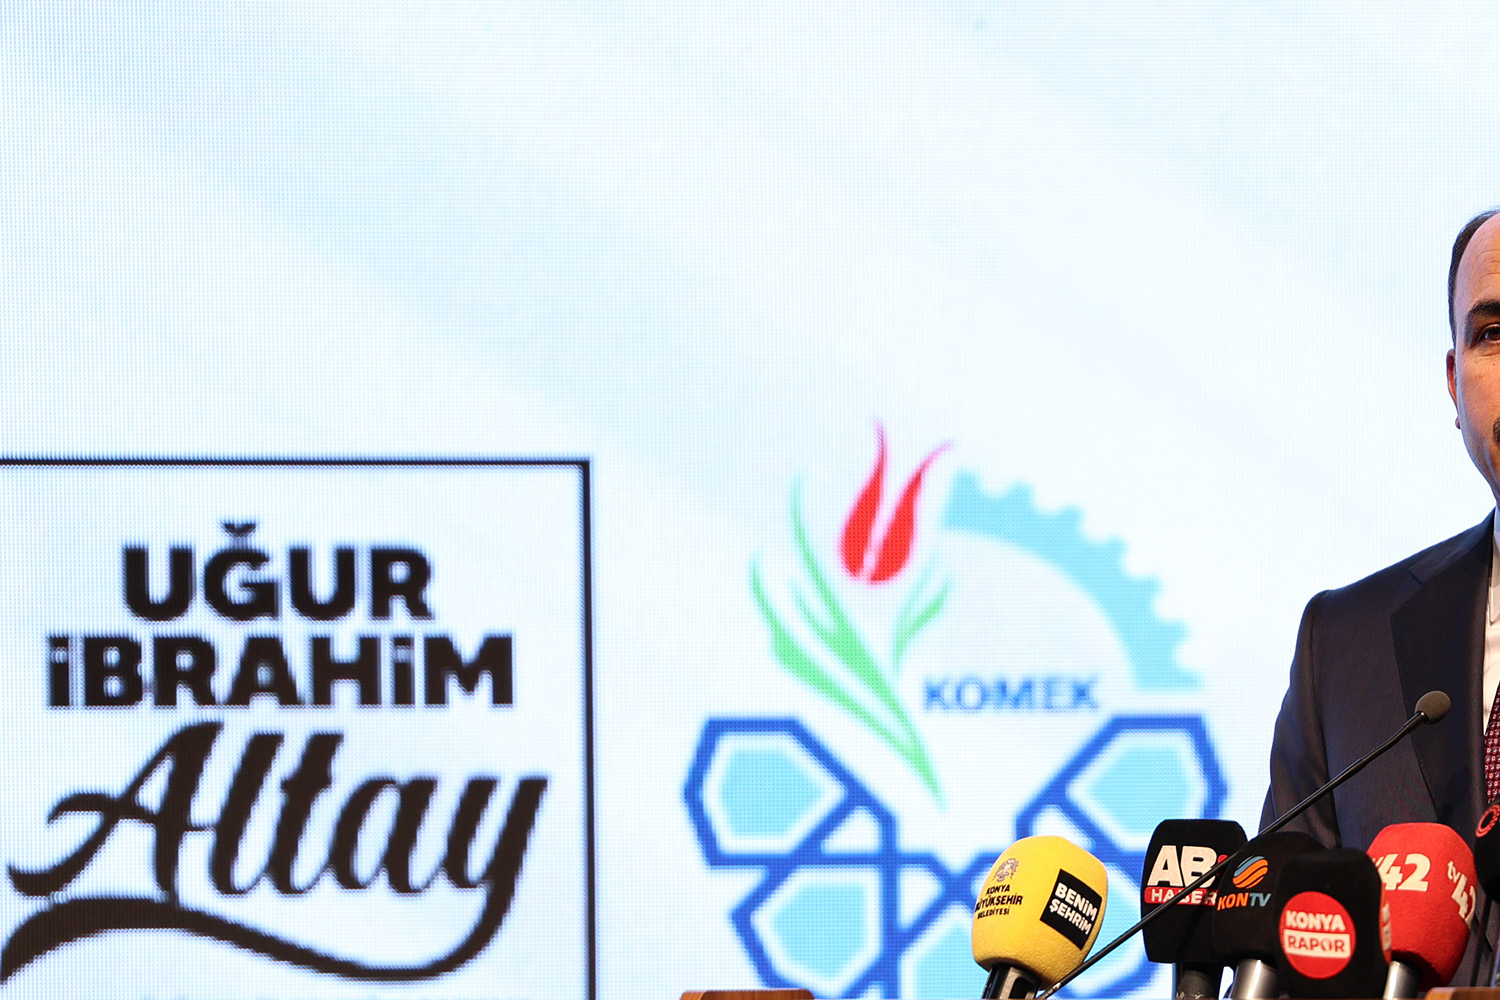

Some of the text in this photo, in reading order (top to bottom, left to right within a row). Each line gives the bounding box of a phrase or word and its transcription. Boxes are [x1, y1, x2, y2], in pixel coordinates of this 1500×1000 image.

[122, 520, 435, 621] UĞUR
[47, 633, 515, 708] İBRAHİM
[925, 678, 1100, 711] KOMEK
[0, 720, 548, 985] Altay
[985, 884, 1011, 896] KONYA
[1054, 882, 1099, 921] BENİM
[1216, 892, 1272, 911] KONTV
[1049, 898, 1092, 935] ŞEHRİM
[1285, 910, 1346, 931] KONYA
[1287, 935, 1345, 952] RAPOR
